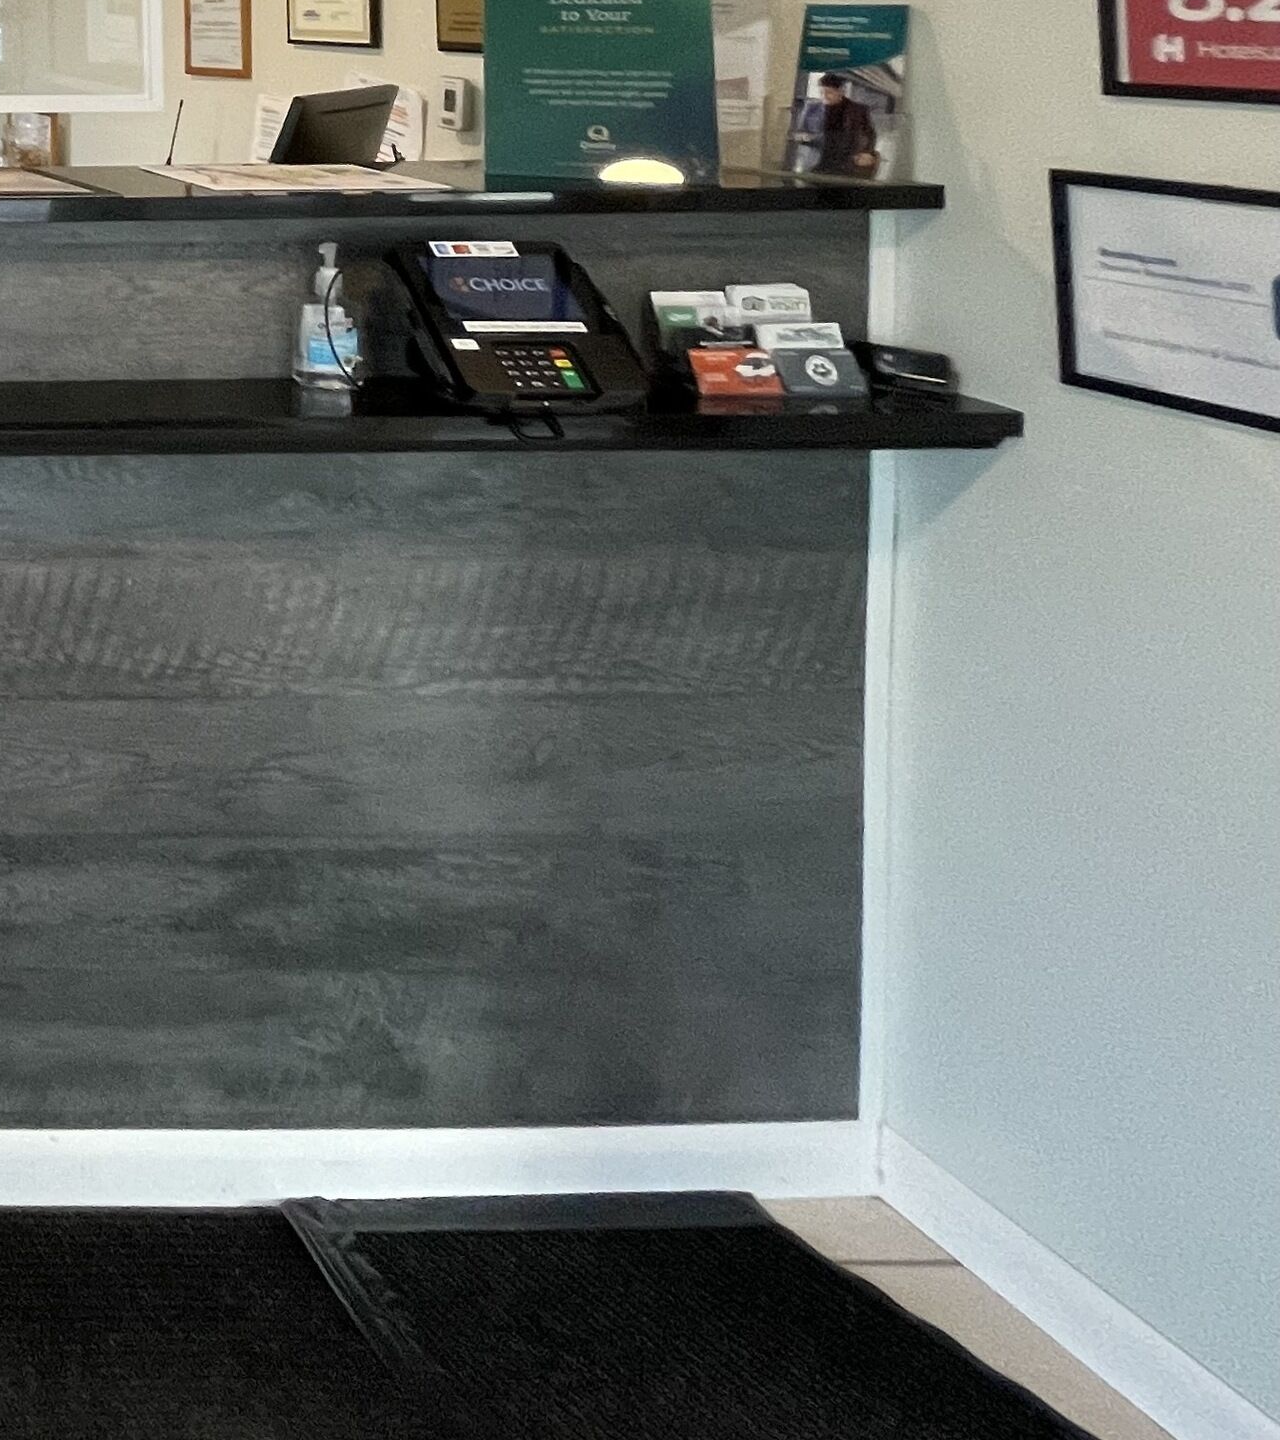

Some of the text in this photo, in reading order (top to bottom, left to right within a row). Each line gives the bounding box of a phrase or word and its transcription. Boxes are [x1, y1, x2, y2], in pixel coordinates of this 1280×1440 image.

[560, 8, 632, 22] to Your
[469, 276, 548, 292] CHOICE
